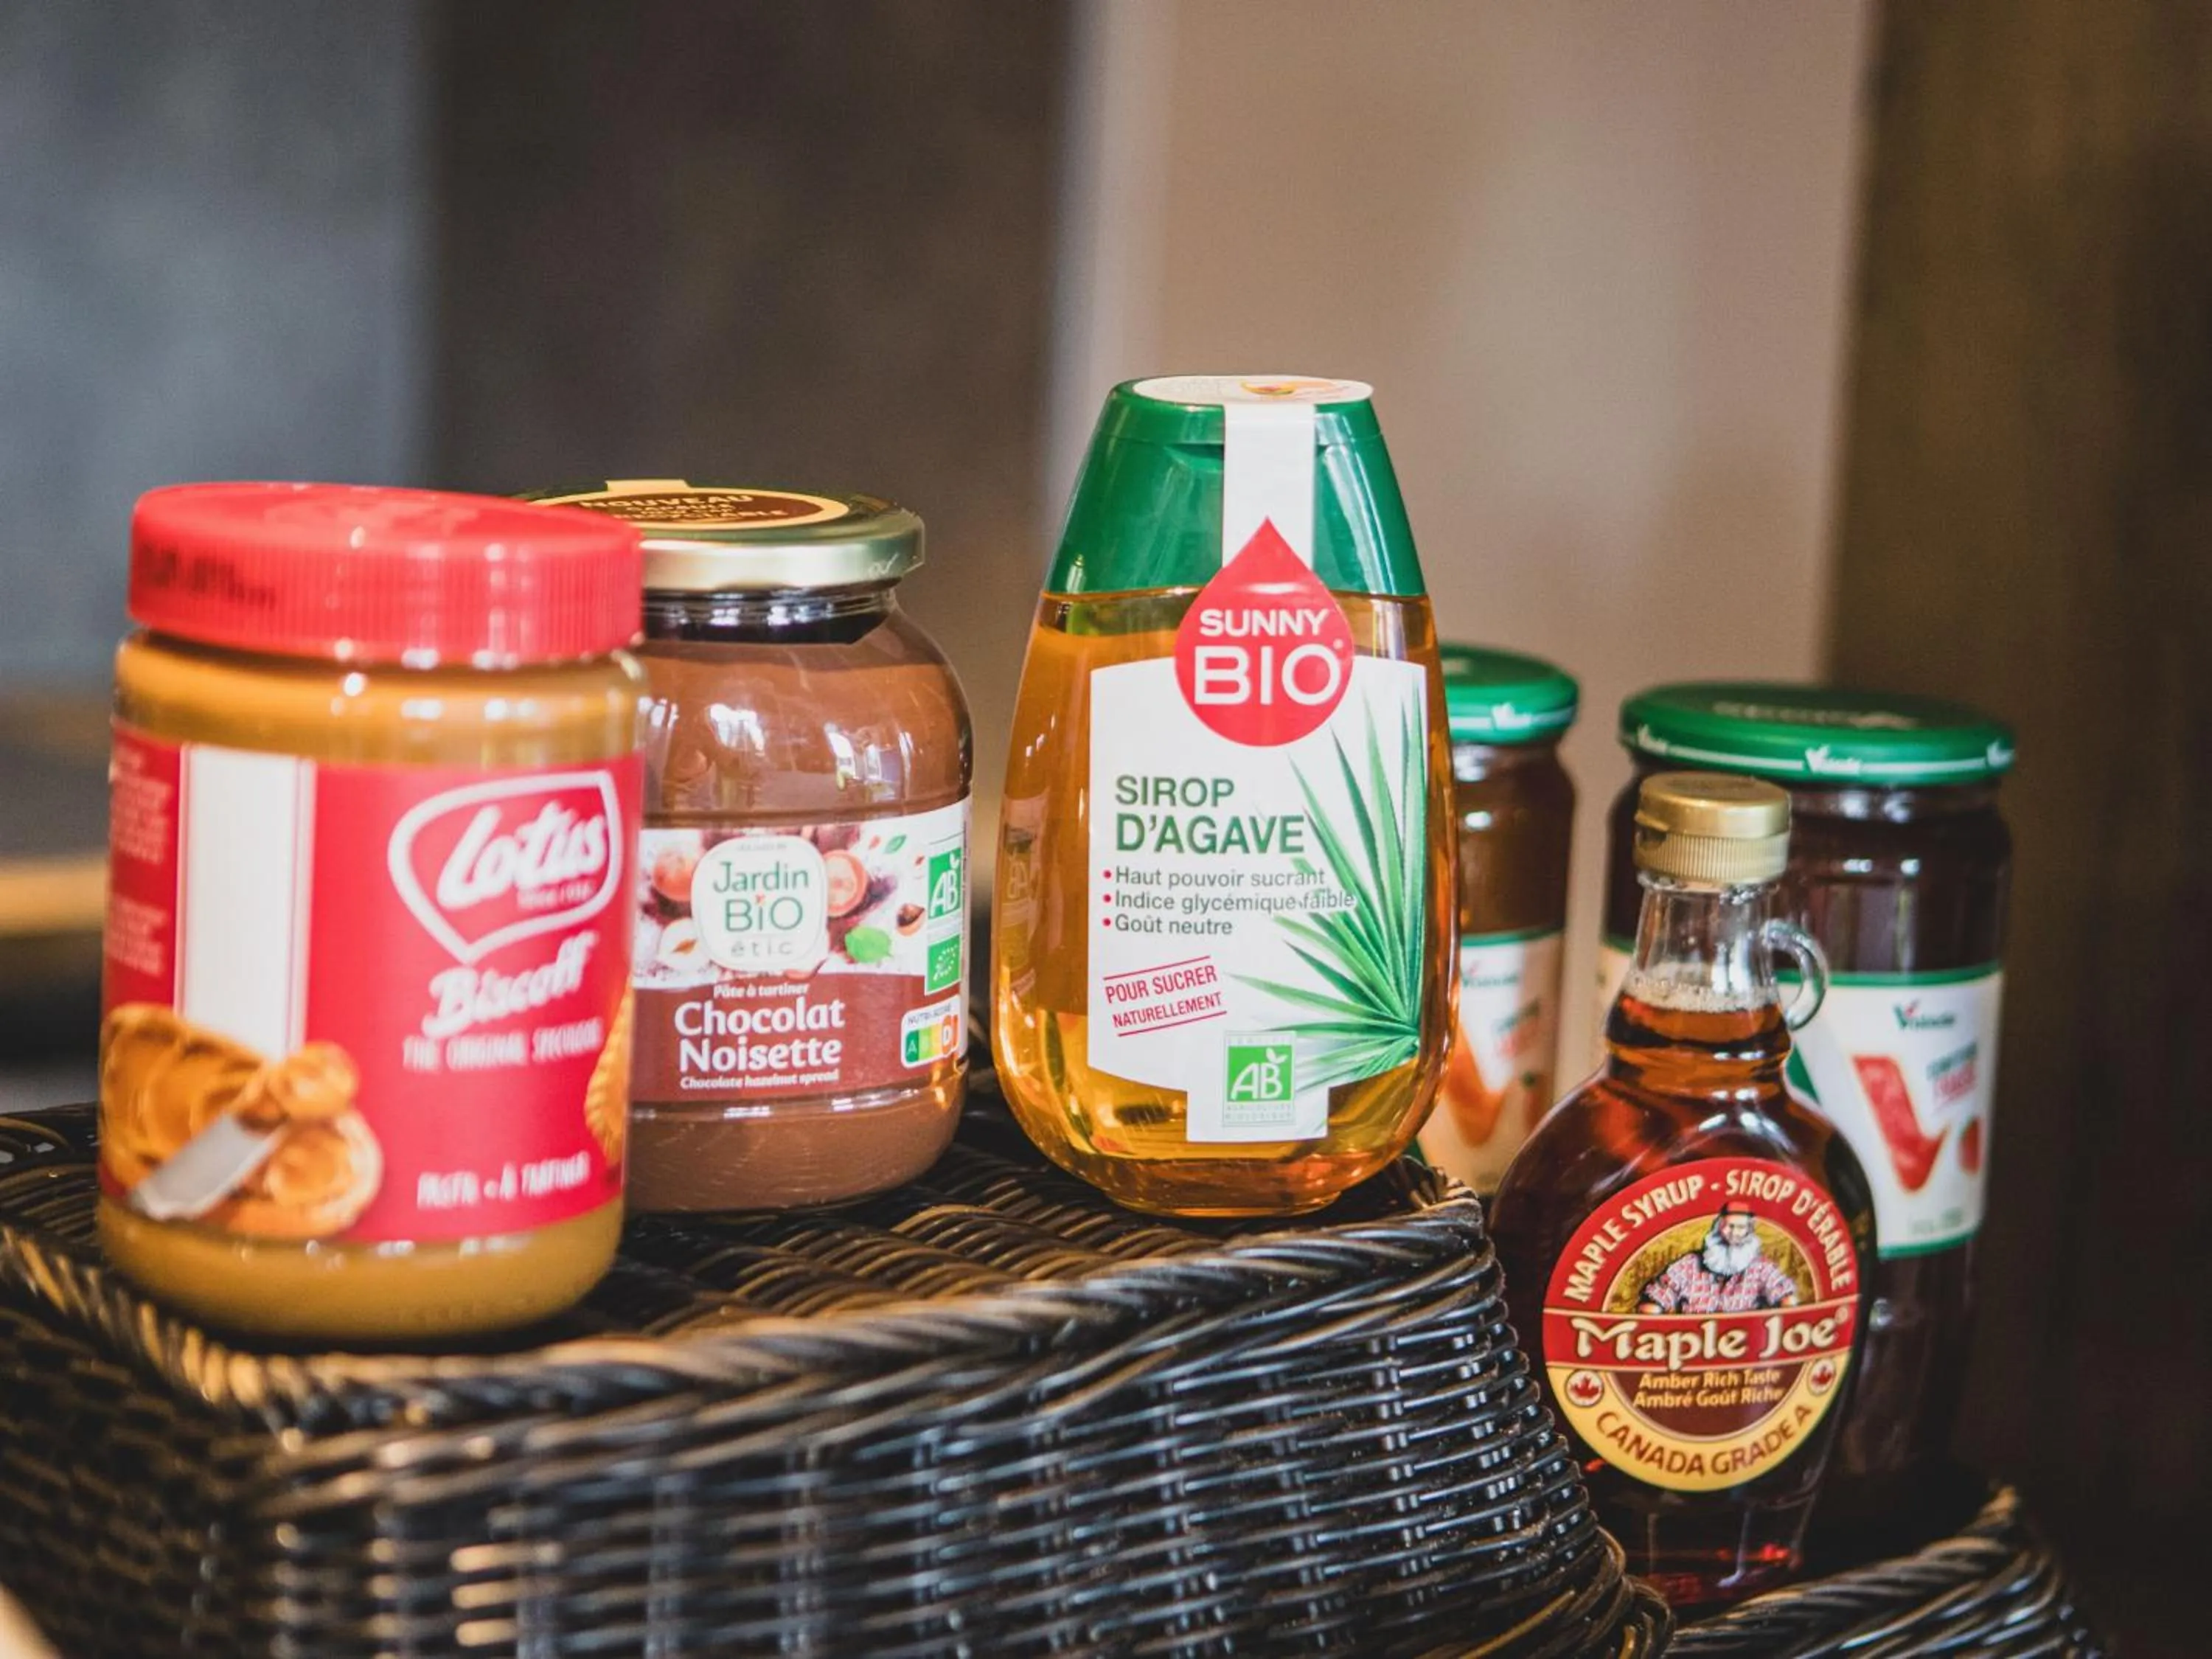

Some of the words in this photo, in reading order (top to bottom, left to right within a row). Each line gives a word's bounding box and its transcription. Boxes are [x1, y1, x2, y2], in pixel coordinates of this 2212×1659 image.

[1199, 608, 1329, 637] SUNNY
[1194, 644, 1340, 705] BIO
[1115, 775, 1234, 807] SIROP
[1116, 813, 1305, 854] D'AGAVE
[437, 800, 605, 910] Lotus
[713, 860, 810, 893] Jardin
[930, 869, 957, 918] AB
[1115, 866, 1161, 886] Haut
[1169, 869, 1244, 890] pouvoir
[1251, 868, 1325, 886] sucrant
[1115, 890, 1175, 910] Indice
[1181, 892, 1297, 914] glycémique
[1304, 891, 1354, 910] faible
[1114, 913, 1162, 933] Goût
[1169, 919, 1232, 934] neutre
[422, 931, 598, 1040] Biscoff
[759, 983, 809, 996] tartiner
[1105, 980, 1150, 1004] POUR
[1152, 965, 1217, 995] SUCRER
[674, 996, 846, 1036] Chocolat
[1113, 992, 1222, 1028] NATURELLEMENT
[679, 1036, 842, 1073] Noisette
[680, 1076, 743, 1090] Chocolate
[744, 1073, 797, 1088] hazelnut
[799, 1068, 839, 1086] spread
[1230, 1062, 1284, 1099] AB
[1564, 1218, 1629, 1302] MAPLE
[1622, 1175, 1705, 1233] SYRUP
[1726, 1169, 1797, 1203] SIROP
[1791, 1189, 1853, 1291] D'ÉRABLE
[1571, 1316, 1747, 1371] Maple
[1639, 1372, 1700, 1389] Amber
[1703, 1370, 1739, 1388] Rich
[1744, 1368, 1781, 1385] Taste
[1633, 1391, 1694, 1408] Ambré
[1697, 1389, 1739, 1406] Goût
[1741, 1388, 1785, 1405] Riche
[1596, 1411, 1705, 1477] CANADA
[1711, 1420, 1795, 1475] GRADE
[1795, 1405, 1812, 1426] A
